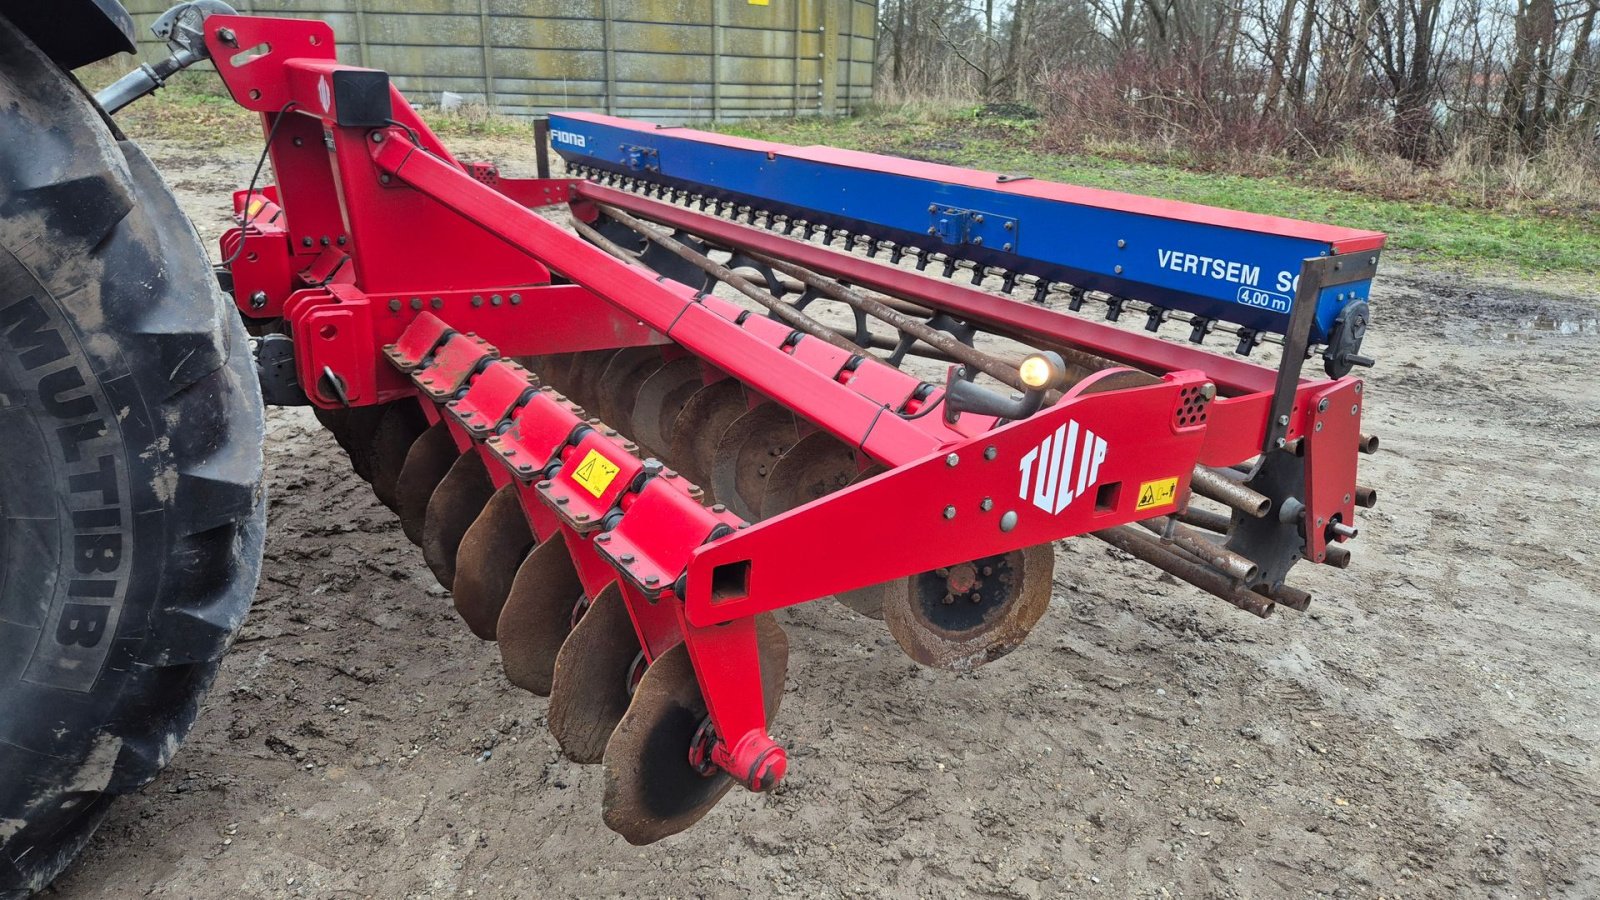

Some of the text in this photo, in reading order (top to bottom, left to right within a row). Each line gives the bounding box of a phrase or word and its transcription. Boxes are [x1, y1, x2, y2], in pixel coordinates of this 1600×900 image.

[1157, 248, 1261, 287] VERTSEM
[1240, 289, 1287, 312] 4,00 m
[0, 294, 123, 649] MULTIBIB
[1018, 418, 1108, 516] TULIP
